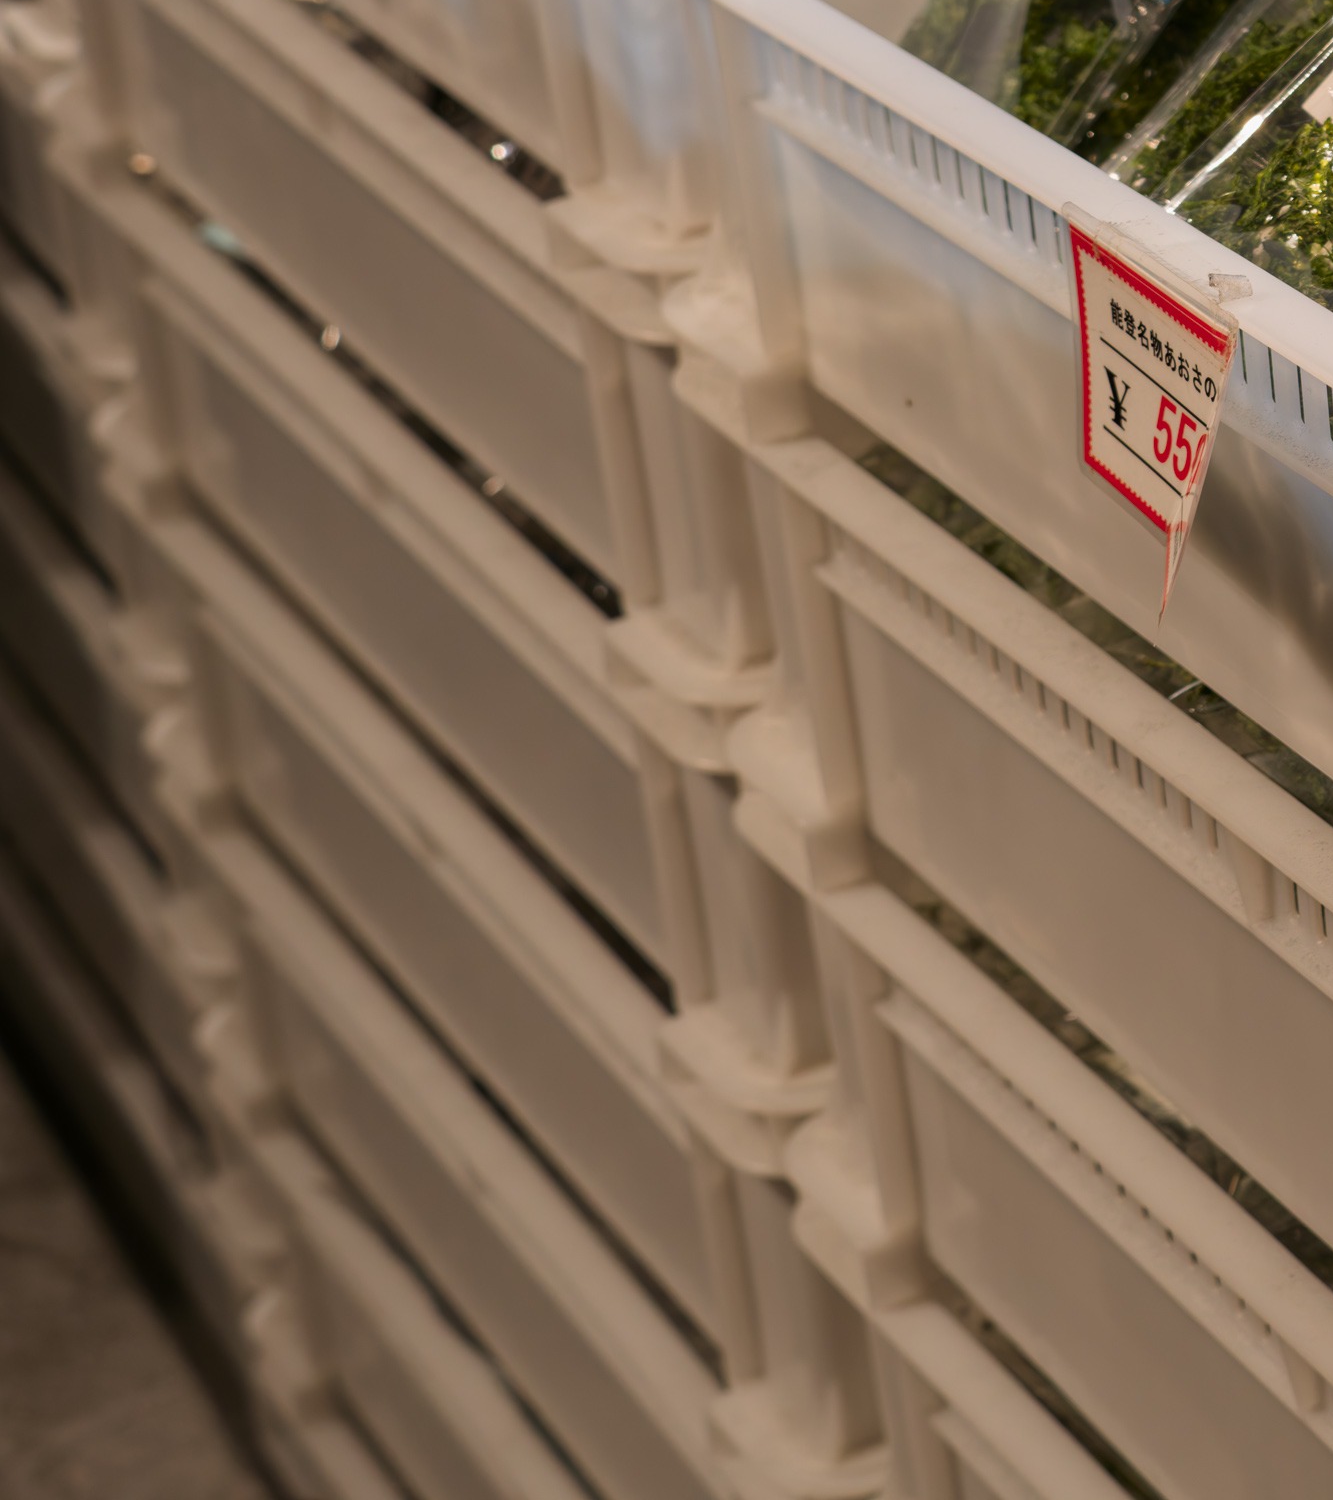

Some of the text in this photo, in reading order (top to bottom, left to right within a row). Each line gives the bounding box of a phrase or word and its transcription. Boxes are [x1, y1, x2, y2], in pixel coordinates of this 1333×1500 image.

[1109, 297, 1217, 403] 能登名物あおさの
[1104, 366, 1131, 430] ¥
